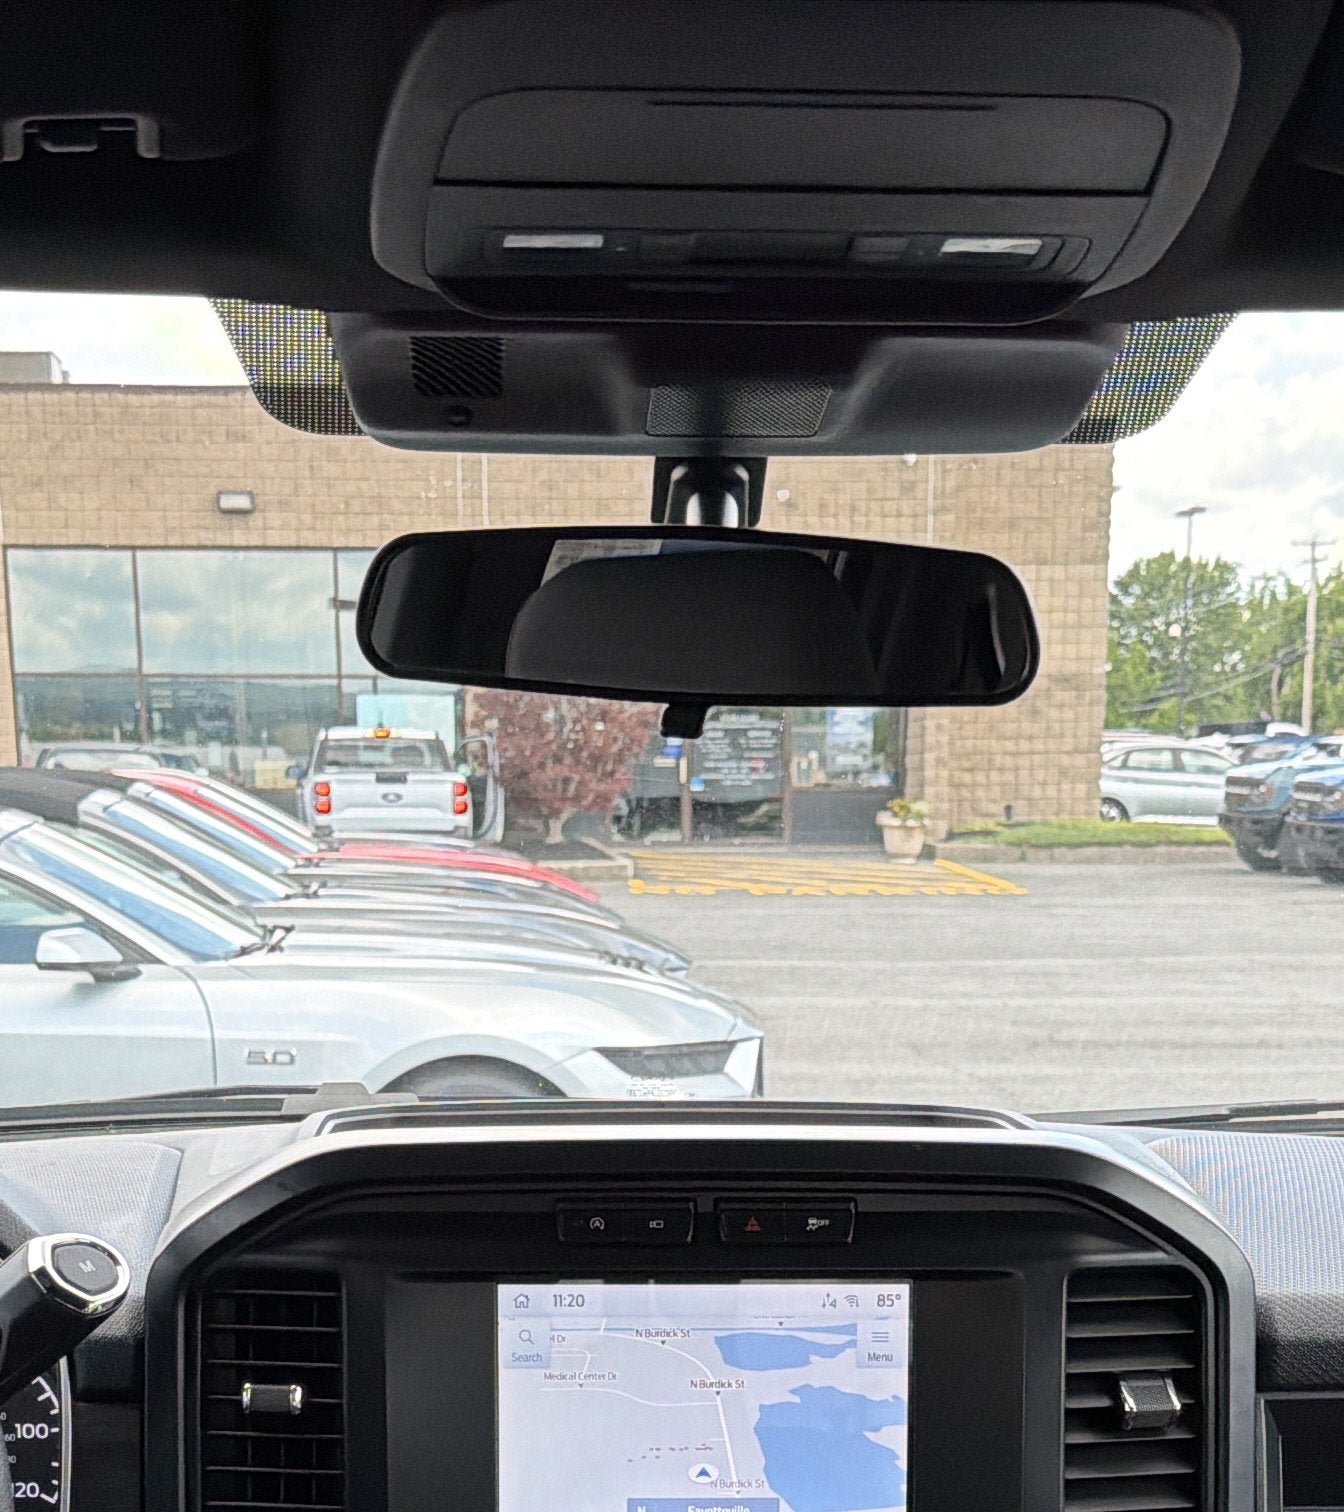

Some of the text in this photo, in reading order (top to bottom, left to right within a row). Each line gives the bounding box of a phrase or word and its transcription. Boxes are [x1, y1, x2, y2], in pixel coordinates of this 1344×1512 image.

[552, 1294, 586, 1308] 11:20
[876, 1294, 902, 1308] 85°
[635, 1328, 690, 1338] N Burdick St
[557, 1335, 566, 1343] Dr
[512, 1354, 542, 1363] Search
[867, 1353, 893, 1362] Menu
[544, 1372, 617, 1381] Medical Center Dr
[690, 1379, 745, 1389] N Burdick St
[14, 1423, 49, 1439] 100
[710, 1479, 765, 1488] N Burdick St
